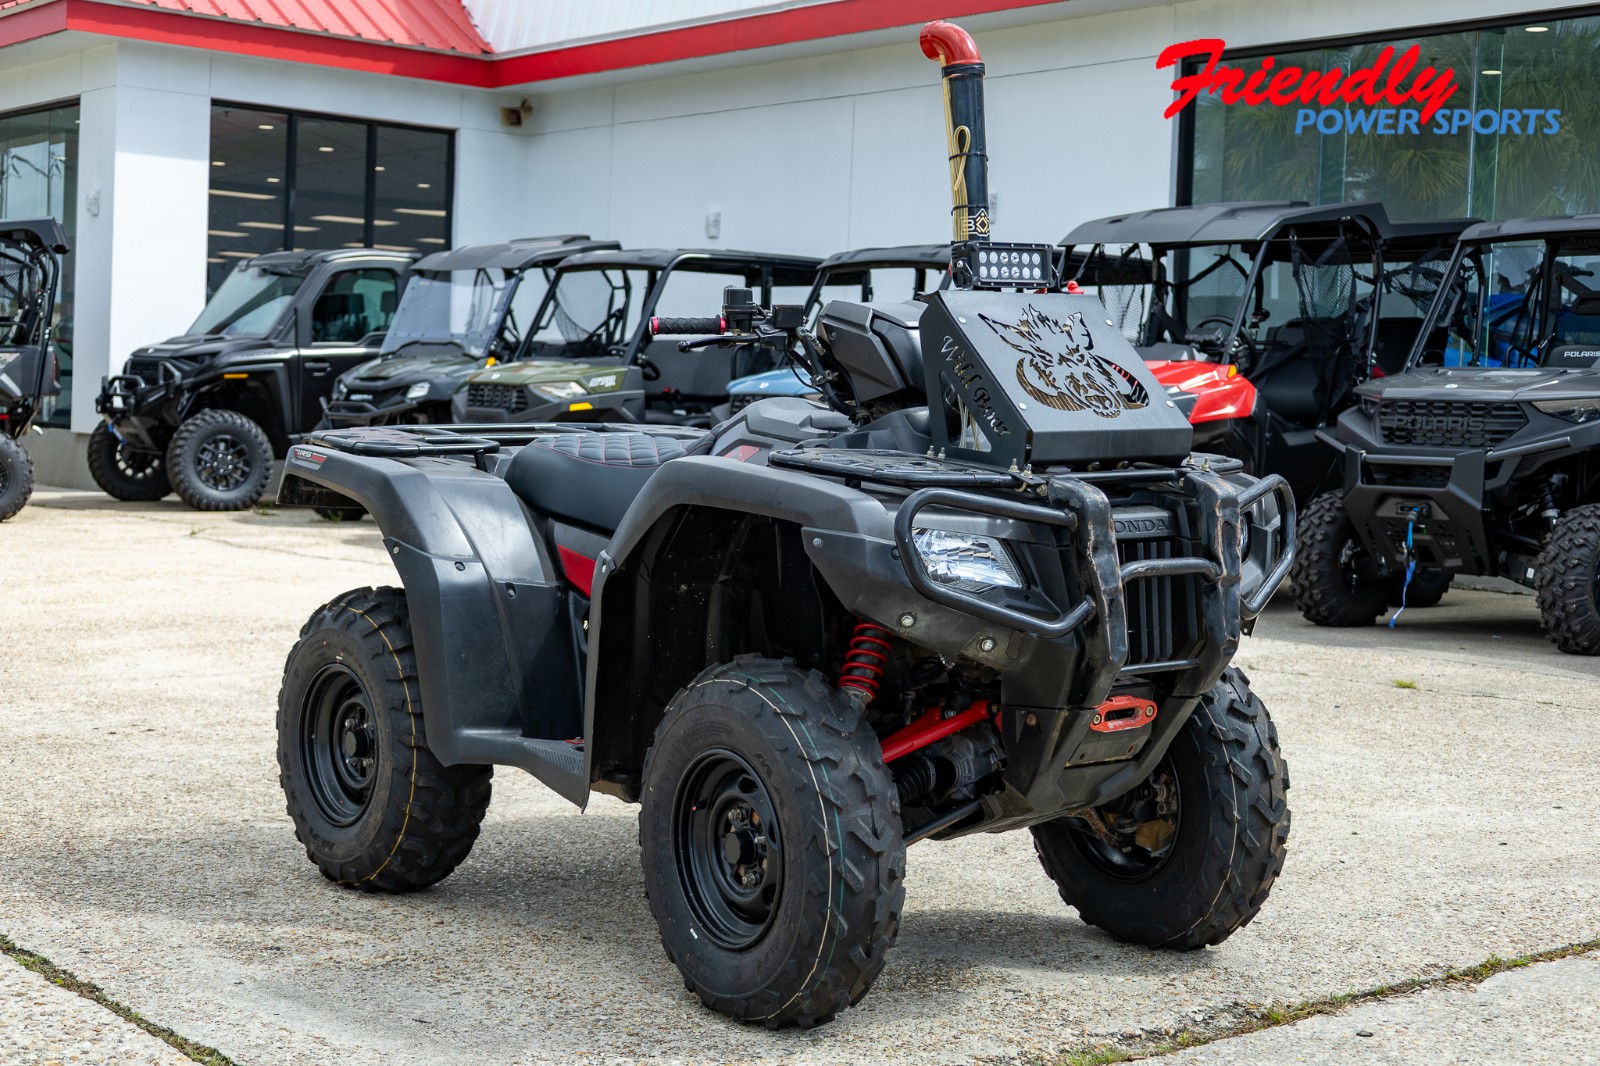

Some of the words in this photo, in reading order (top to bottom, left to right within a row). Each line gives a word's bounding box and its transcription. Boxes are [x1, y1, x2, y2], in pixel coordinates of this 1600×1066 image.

[1563, 350, 1600, 358] POLARIS
[1393, 416, 1486, 431] POLARIS
[1114, 518, 1171, 534] ONDA
